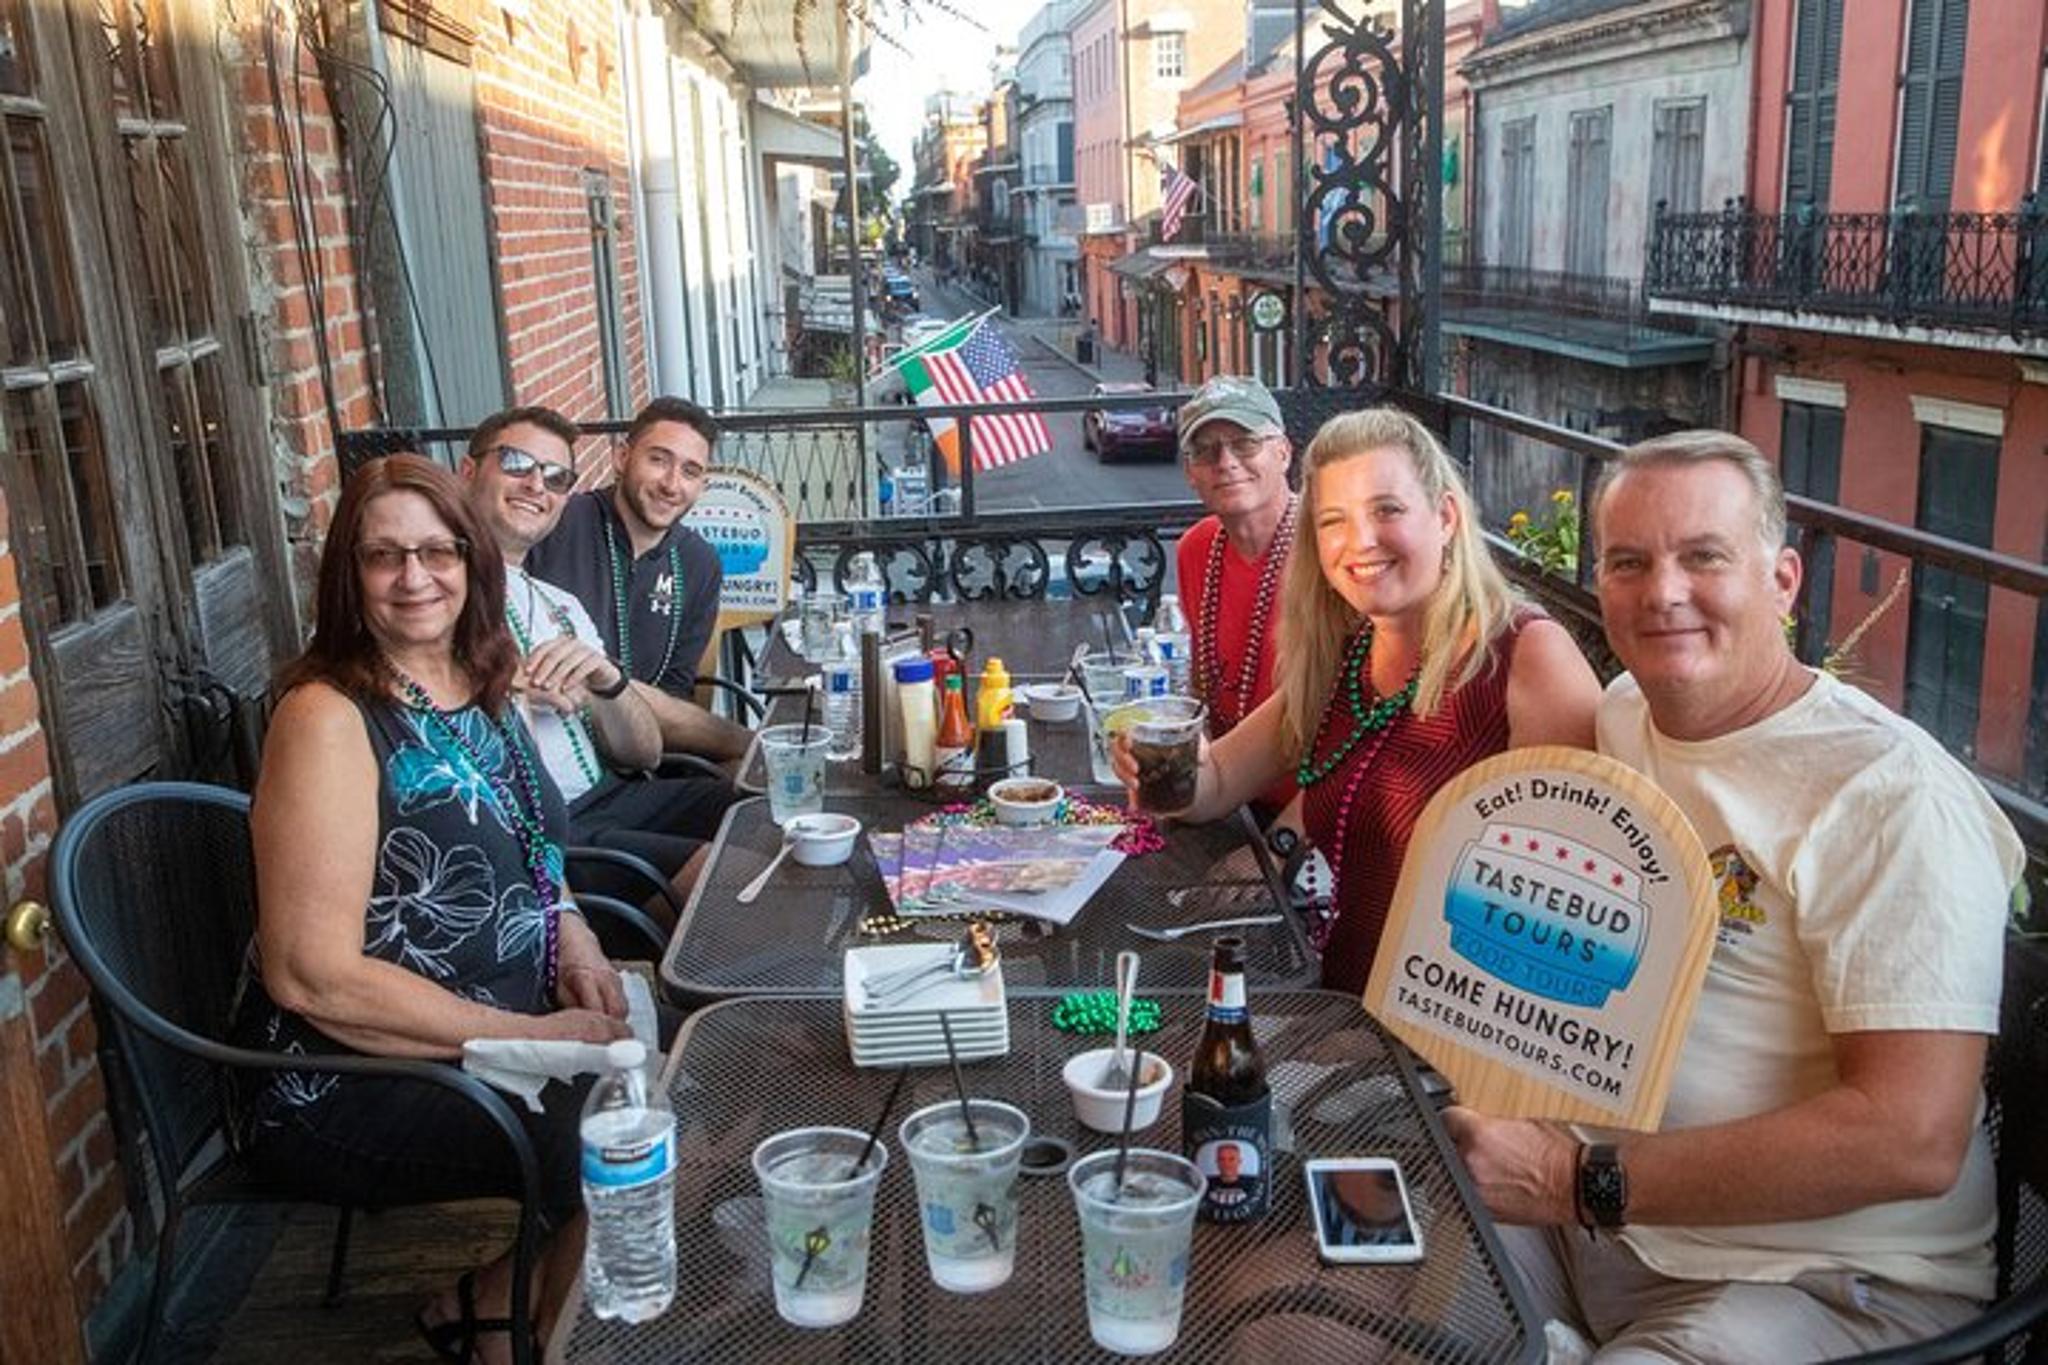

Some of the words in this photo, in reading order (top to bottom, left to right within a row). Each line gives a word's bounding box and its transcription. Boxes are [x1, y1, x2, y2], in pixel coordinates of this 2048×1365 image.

[721, 580, 777, 593] UNGRY!
[1474, 782, 1522, 820] Eat!
[1531, 778, 1611, 815] Drink!
[1611, 806, 1670, 885] Enjoy!
[1473, 859, 1631, 934] TASTEBUD
[1483, 901, 1598, 963] TOURS
[1453, 927, 1517, 975] FOOD
[1520, 960, 1605, 1004] TOURS
[1398, 986, 1623, 1097] TASTEBUDTOURS.COM
[1404, 954, 1487, 1007] COME
[1493, 990, 1635, 1070] HUNGRY!
